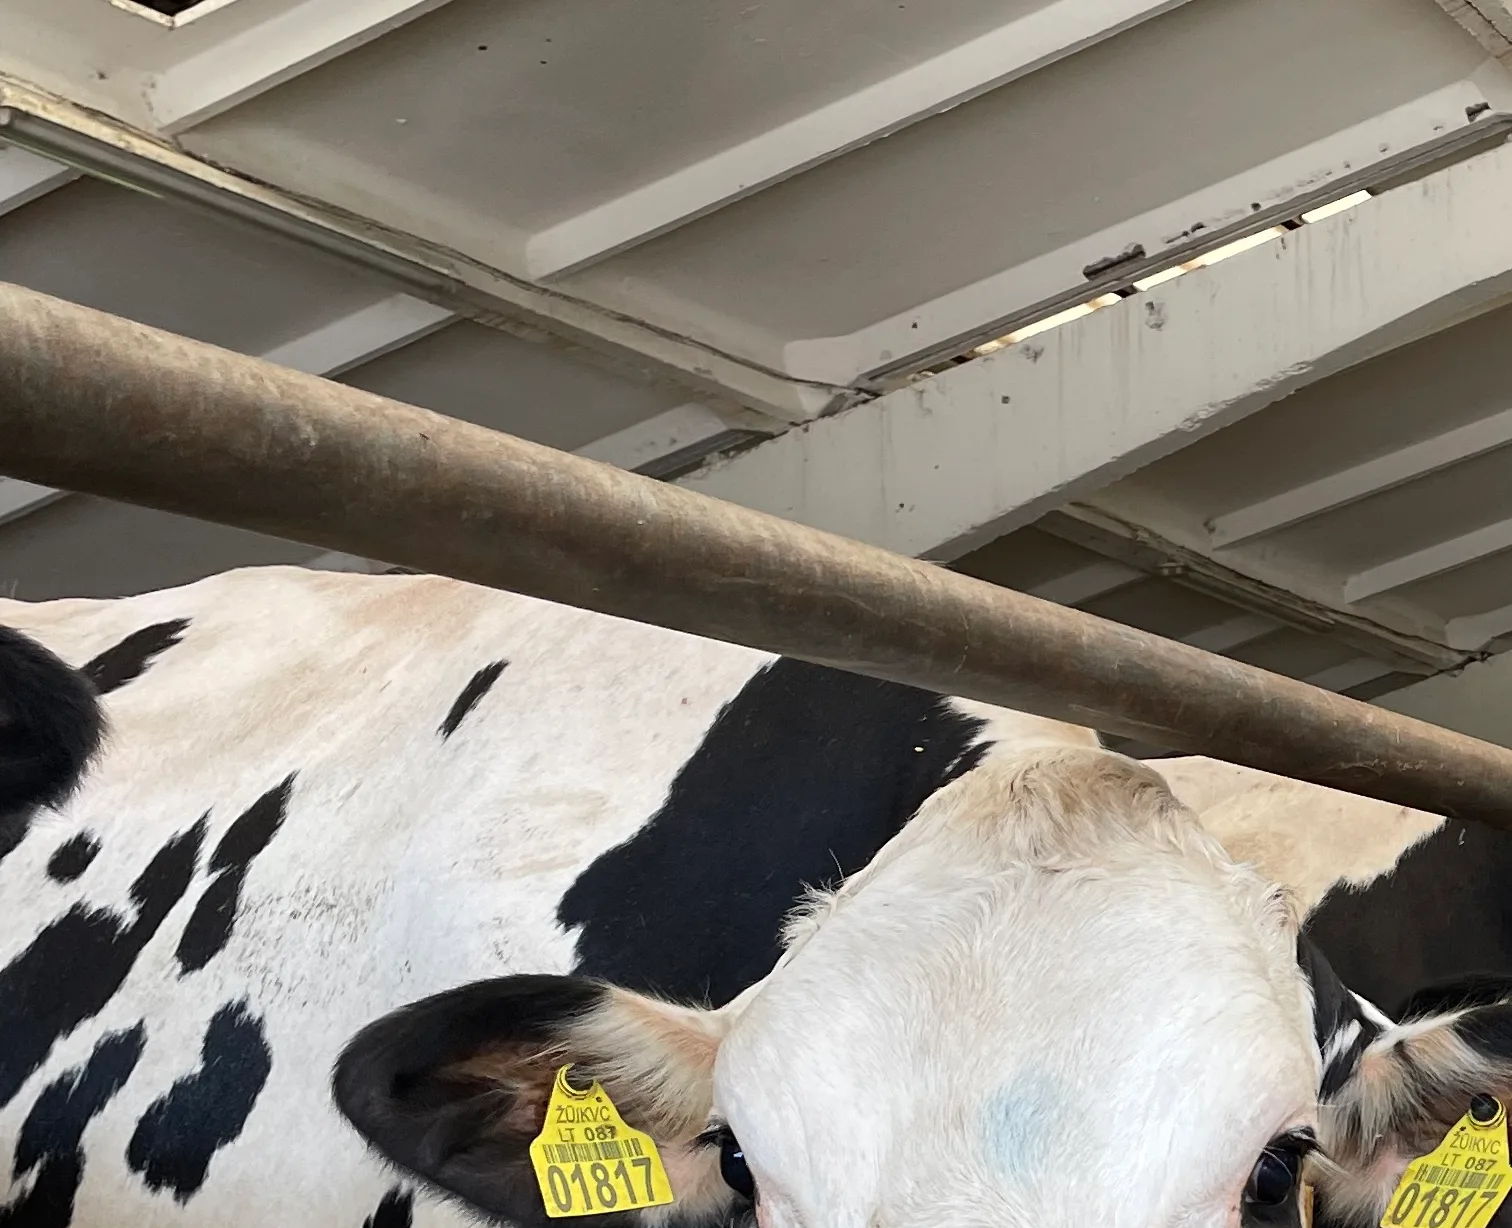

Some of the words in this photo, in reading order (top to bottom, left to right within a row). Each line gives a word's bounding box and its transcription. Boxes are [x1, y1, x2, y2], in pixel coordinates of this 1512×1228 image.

[557, 1127, 576, 1143] LT
[584, 1124, 617, 1141] 087
[1441, 1153, 1462, 1167] LT
[1465, 1156, 1498, 1171] 087
[547, 1157, 655, 1213] 01817
[1391, 1182, 1499, 1228] 01817
